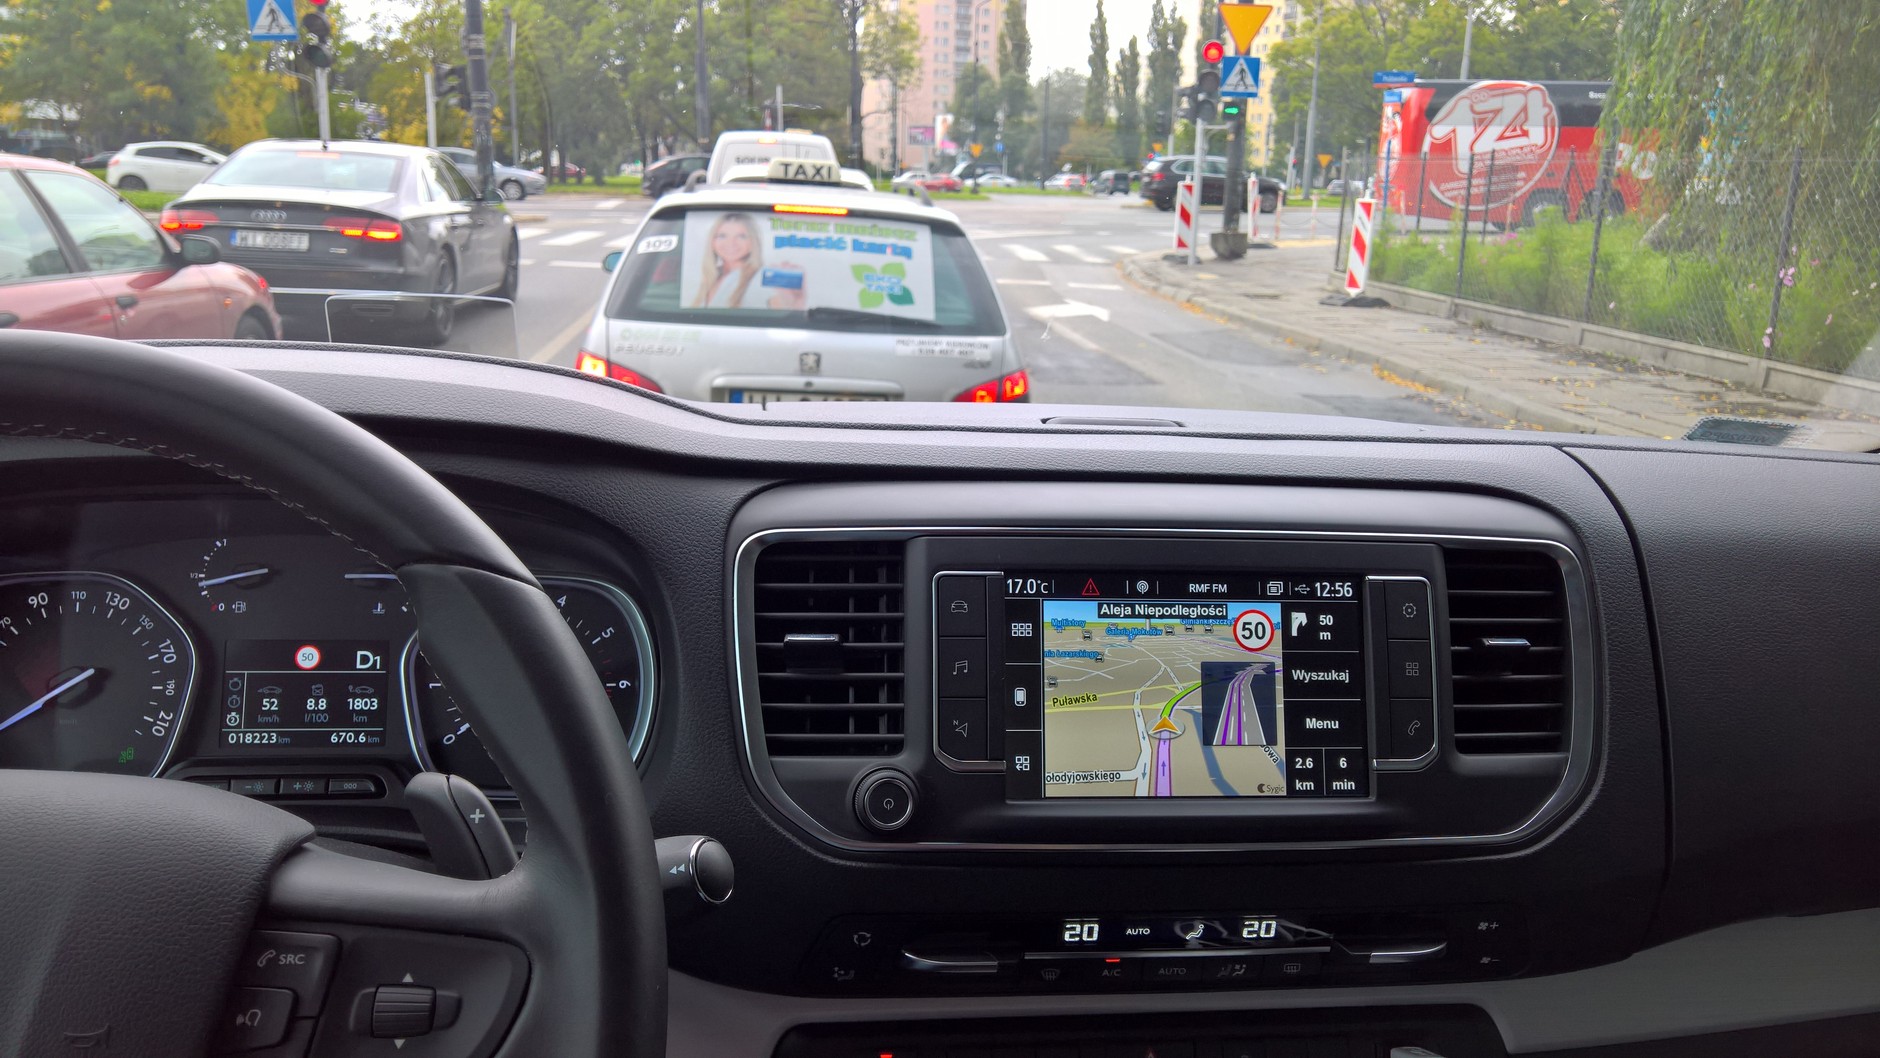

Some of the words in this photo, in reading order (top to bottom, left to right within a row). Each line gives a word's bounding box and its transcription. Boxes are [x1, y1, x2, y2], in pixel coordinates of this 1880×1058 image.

[780, 163, 832, 179] TAXI
[645, 239, 673, 248] 109
[1189, 584, 1210, 593] RMF
[1212, 584, 1227, 593] FM
[1315, 581, 1353, 598] 12:56
[28, 592, 49, 609] 90
[71, 591, 87, 600] 110
[105, 591, 130, 611] 130
[556, 595, 567, 608] 4
[218, 602, 225, 612] 0
[1100, 603, 1132, 618] Aleja
[1135, 604, 1227, 618] Niepodległości
[139, 614, 154, 630] 150
[1051, 618, 1087, 628] Multistory
[1319, 615, 1334, 626] 50
[602, 626, 615, 639] 5
[1105, 627, 1129, 637] Galeria
[1241, 621, 1267, 640] 50
[1319, 632, 1331, 640] m
[158, 638, 177, 664] 170
[301, 652, 314, 662] 50
[1292, 669, 1350, 683] Wyszukaj
[165, 679, 175, 696] 190
[618, 679, 631, 689] 6
[261, 698, 279, 711] 52
[306, 698, 327, 711] 8.8
[347, 698, 378, 711] 1803
[1052, 692, 1098, 707] Puławska
[152, 710, 174, 737] 210
[257, 714, 280, 724] km/h
[353, 713, 368, 723] km
[1305, 718, 1339, 729] Menu
[228, 732, 277, 744] 018223
[278, 735, 291, 744] km
[330, 732, 367, 744] 670.6
[367, 735, 380, 744] km
[443, 733, 456, 745] 0
[1295, 758, 1314, 768] 2.6
[1339, 757, 1347, 768] 6
[1266, 784, 1285, 794] Sygic
[1295, 779, 1315, 790] km
[1332, 779, 1355, 790] min
[1064, 923, 1100, 942] 20
[1242, 920, 1277, 938] 20
[278, 953, 305, 965] SRC
[1102, 969, 1121, 977] A/C
[1158, 967, 1186, 975] AUTO
